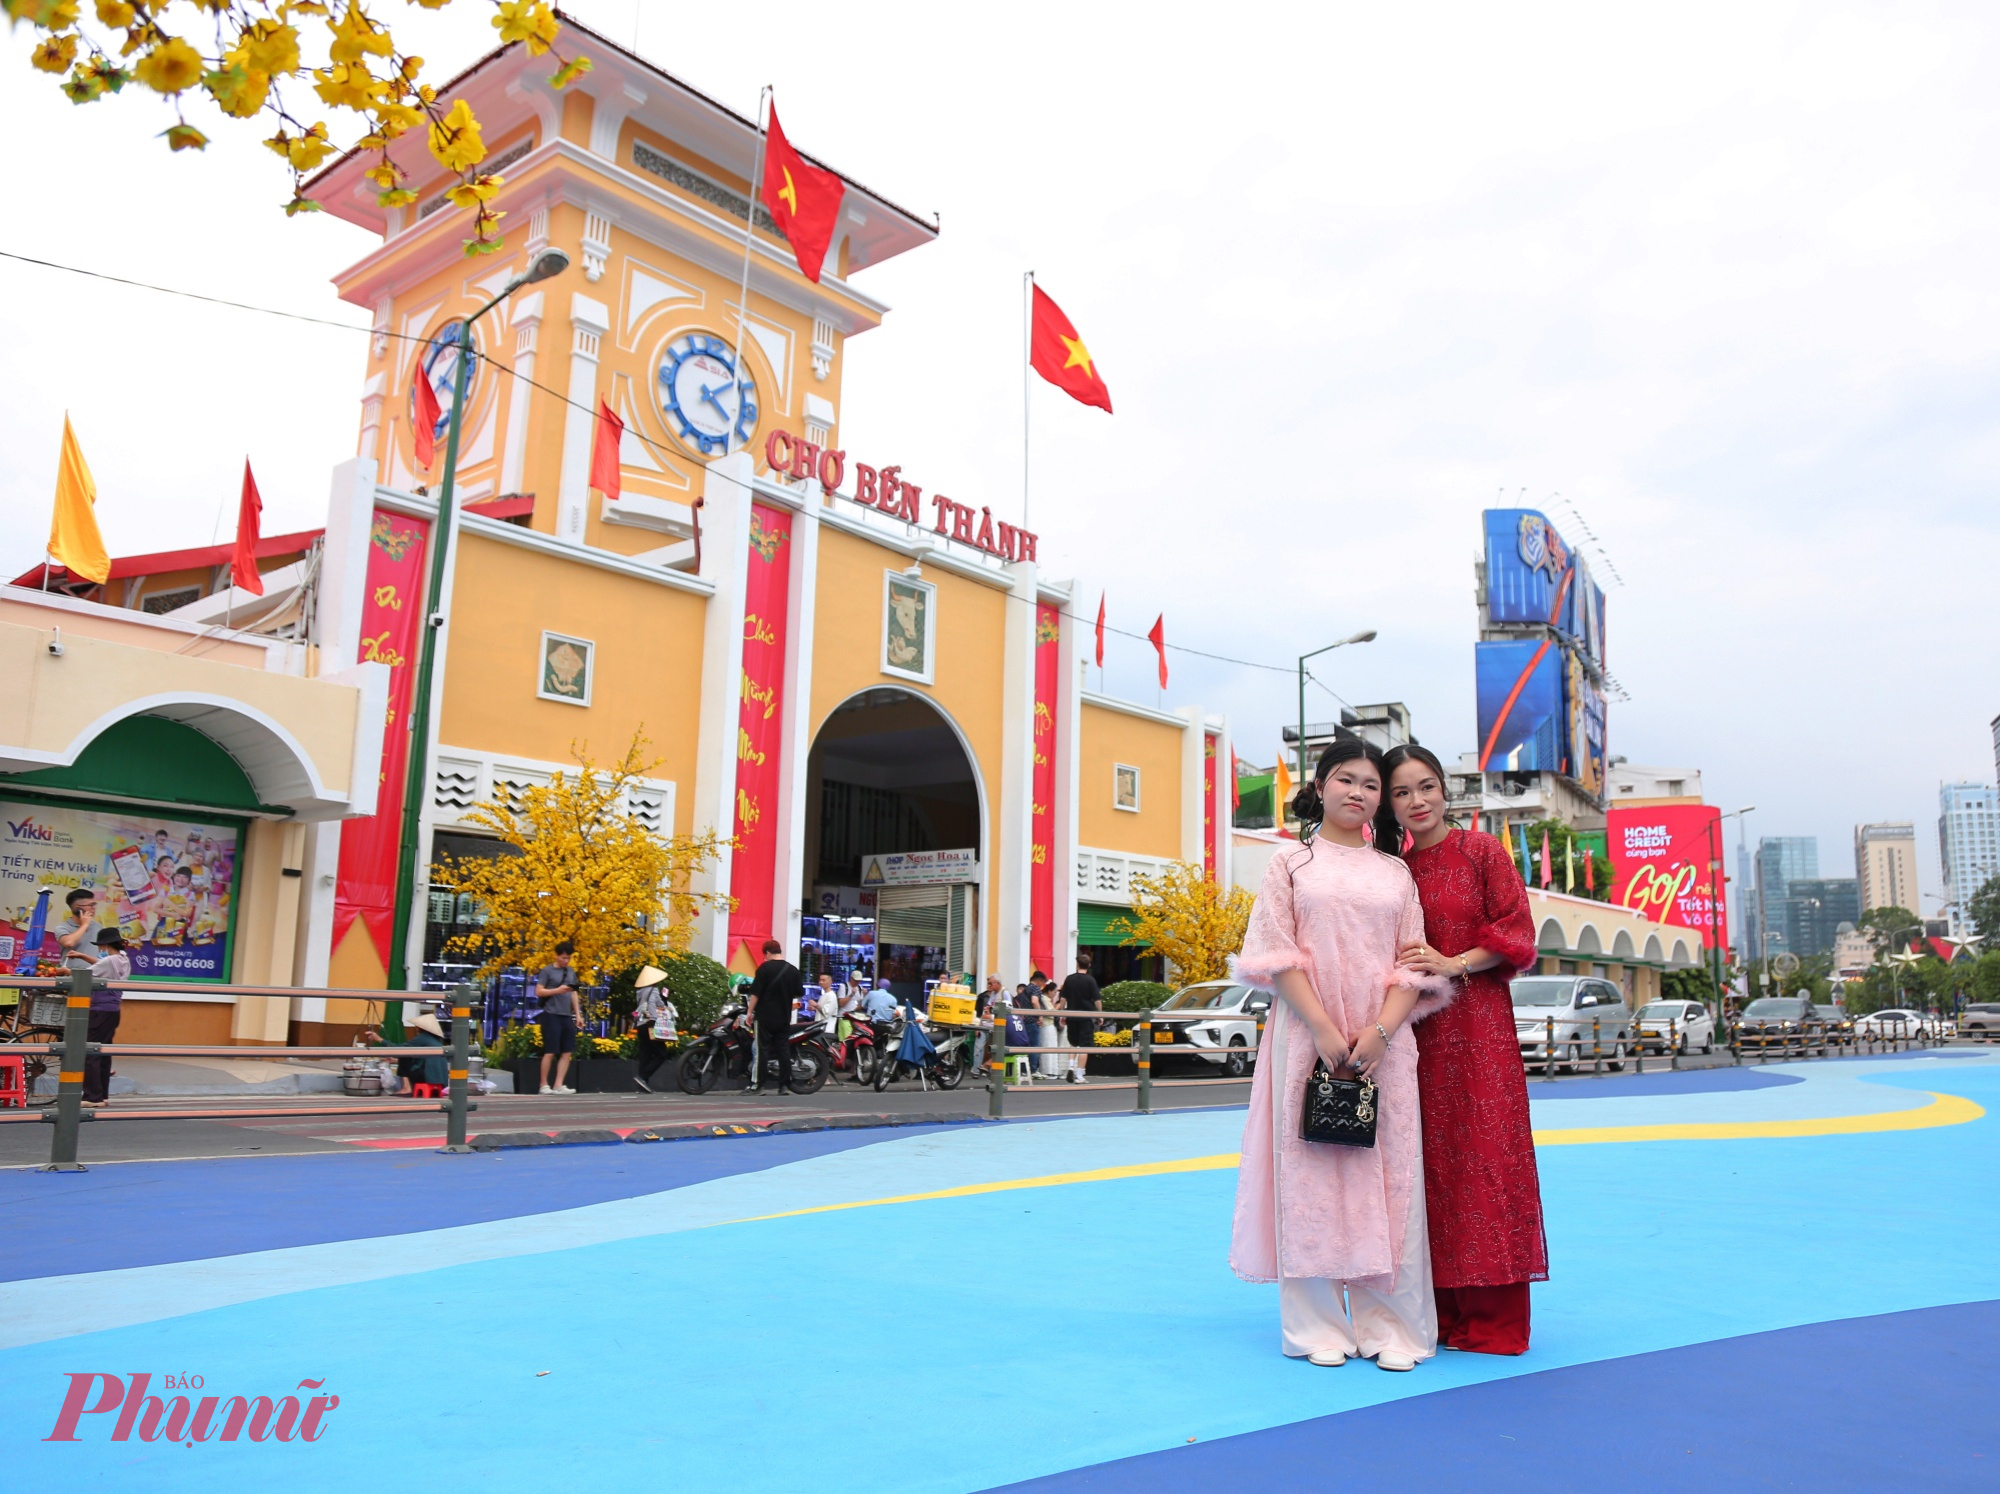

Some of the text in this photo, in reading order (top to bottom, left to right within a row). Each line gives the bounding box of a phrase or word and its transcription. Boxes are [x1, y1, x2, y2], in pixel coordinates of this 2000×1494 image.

[765, 429, 1039, 563] CHỢ BẾN THÀNH
[743, 614, 776, 645] Chúc
[740, 666, 778, 720] Mừng
[1032, 803, 1048, 816] ear
[7, 816, 53, 841] Vikki
[1624, 825, 1667, 838] HOME
[1624, 836, 1672, 848] CREDIT
[937, 852, 960, 860] Hoa
[1032, 844, 1046, 865] 026
[2, 853, 97, 873] TIẾT KIỆM Vikki
[1, 868, 35, 882] Trúng
[38, 870, 79, 889] VÀNG
[1677, 896, 1703, 911] Tết
[1704, 913, 1723, 926] Gá
[153, 957, 215, 969] 1900 6608
[1012, 1020, 1023, 1032] 16
